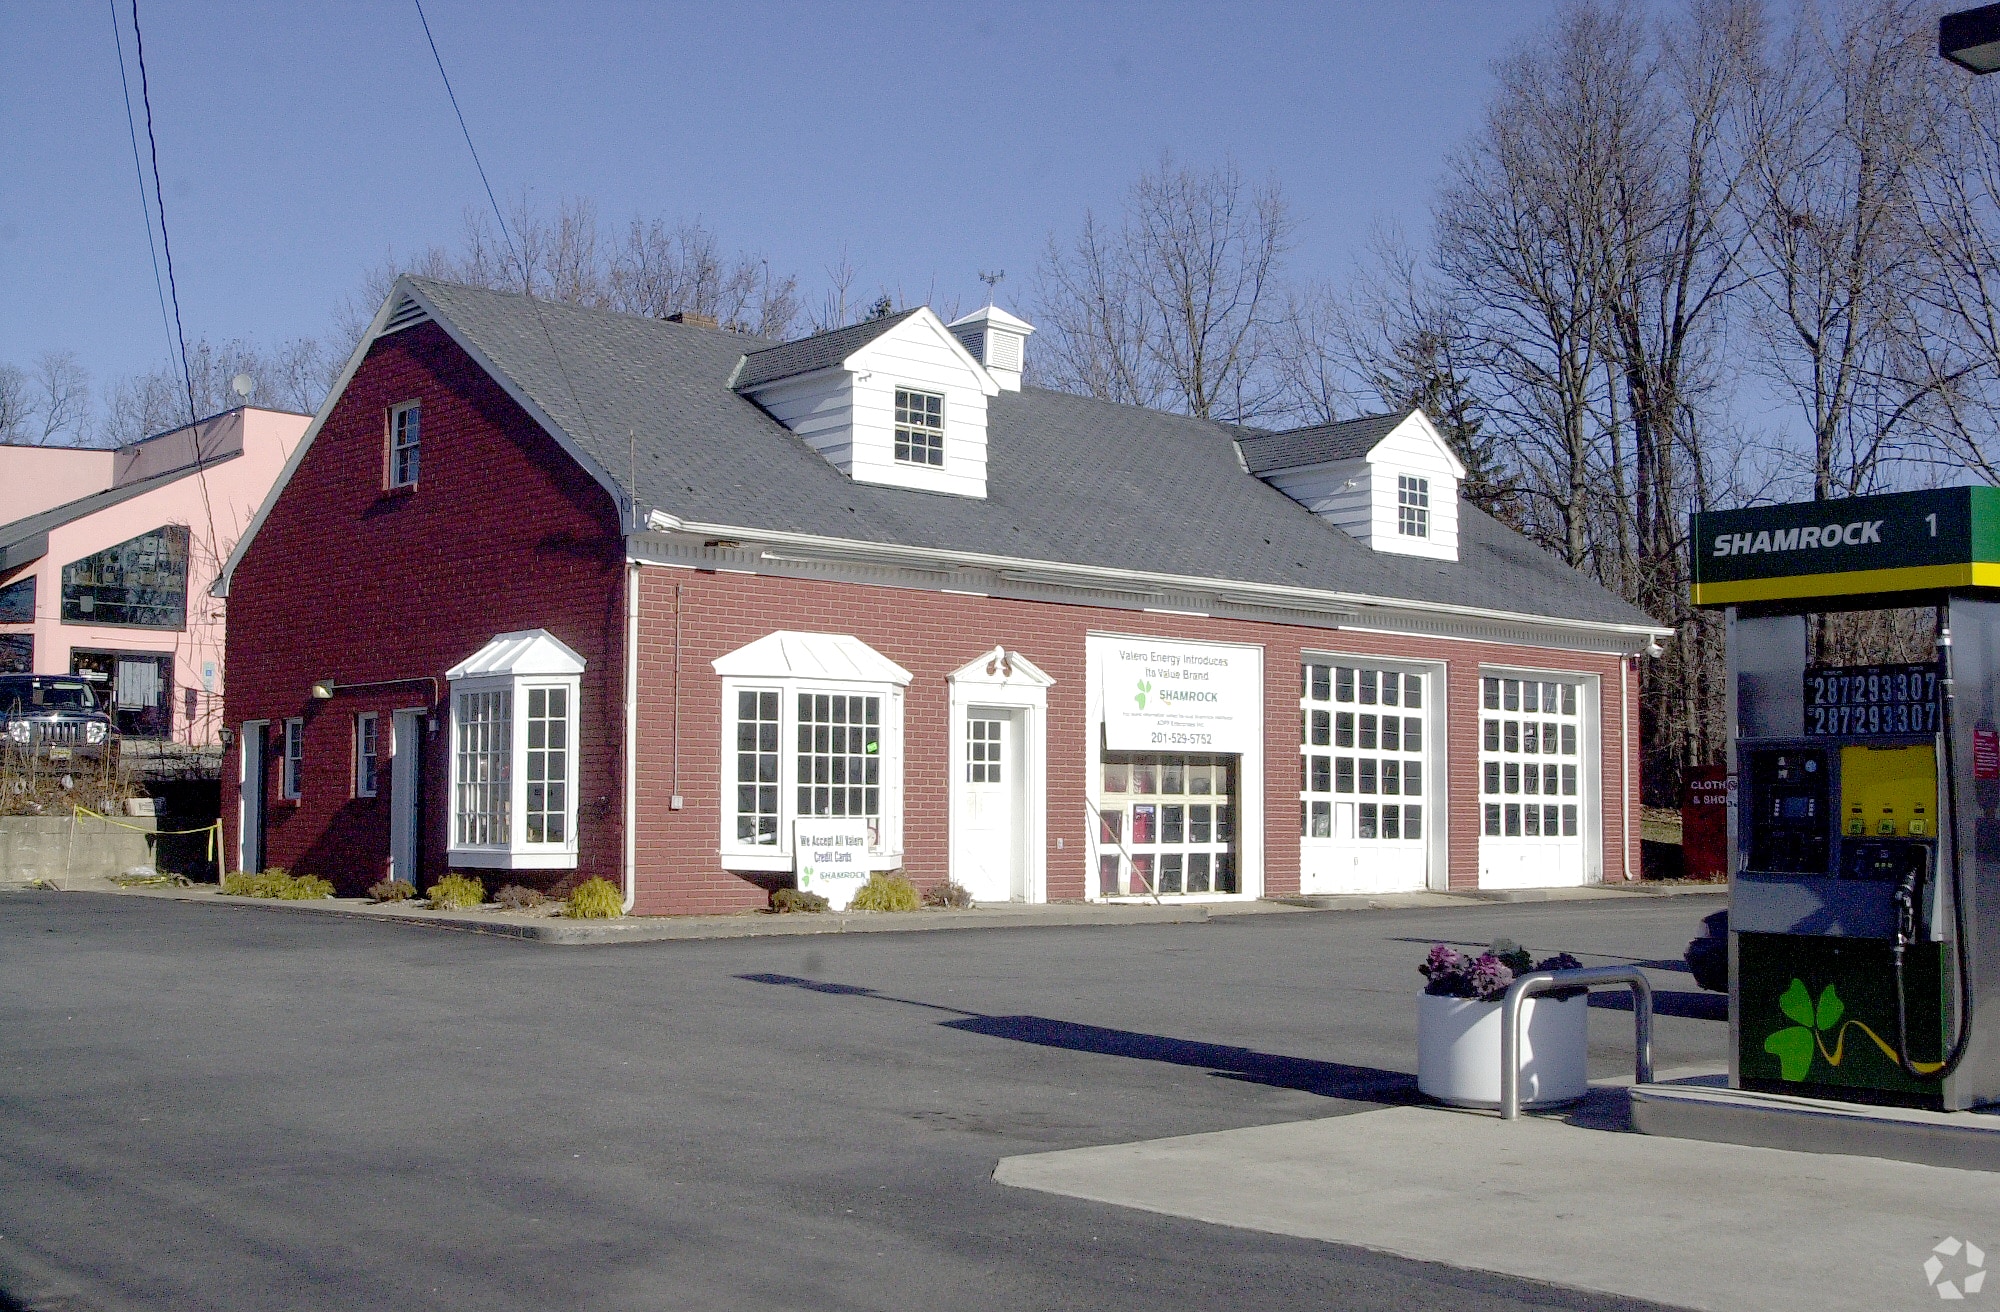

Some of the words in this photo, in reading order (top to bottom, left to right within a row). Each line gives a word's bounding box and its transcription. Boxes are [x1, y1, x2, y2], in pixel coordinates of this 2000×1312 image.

[1925, 513, 1938, 537] 1
[1713, 520, 1884, 557] SHAMROCK
[1119, 650, 1148, 662] Valero
[1150, 652, 1181, 666] Energy
[1183, 655, 1229, 667] Introduces
[1158, 668, 1180, 679] Value
[1183, 670, 1209, 680] Brand
[1814, 677, 1850, 704] 287
[1856, 675, 1893, 703] 293
[1897, 672, 1936, 701] 307
[1159, 689, 1218, 702] SHAMROCK
[1815, 706, 1851, 735] 287
[1856, 705, 1894, 734] 293
[1898, 702, 1936, 732] 307
[1151, 731, 1212, 745] 201-529-5752
[800, 835, 811, 847] We
[812, 835, 834, 847] Accept
[835, 835, 844, 847] All
[814, 851, 833, 863] Credit
[834, 851, 852, 863] Cards
[820, 871, 866, 879] SHAMROCK
